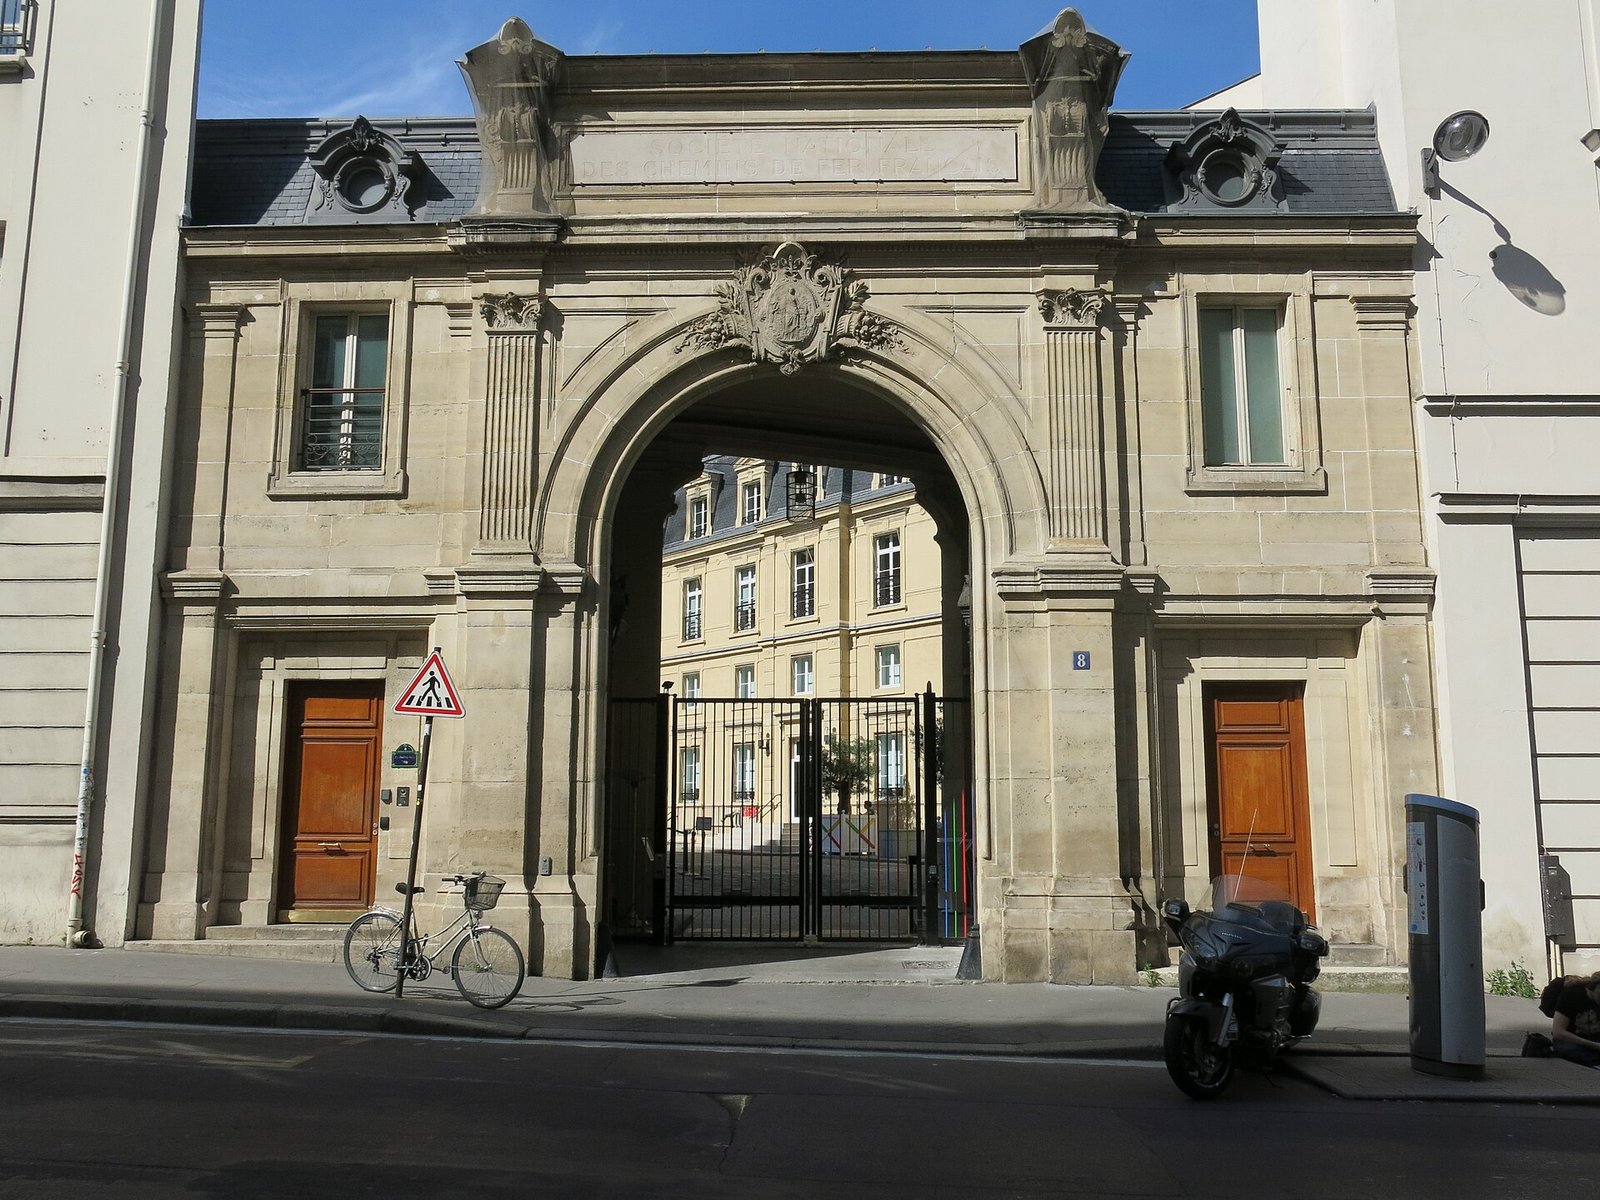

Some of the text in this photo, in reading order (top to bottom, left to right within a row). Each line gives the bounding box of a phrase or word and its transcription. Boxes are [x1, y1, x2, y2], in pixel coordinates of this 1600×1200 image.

[784, 135, 934, 155] NATIONALE
[583, 160, 629, 178] DES
[643, 159, 759, 178] CHEMINS
[772, 158, 803, 176] DE
[817, 158, 863, 176] FER
[1077, 653, 1086, 667] 8
